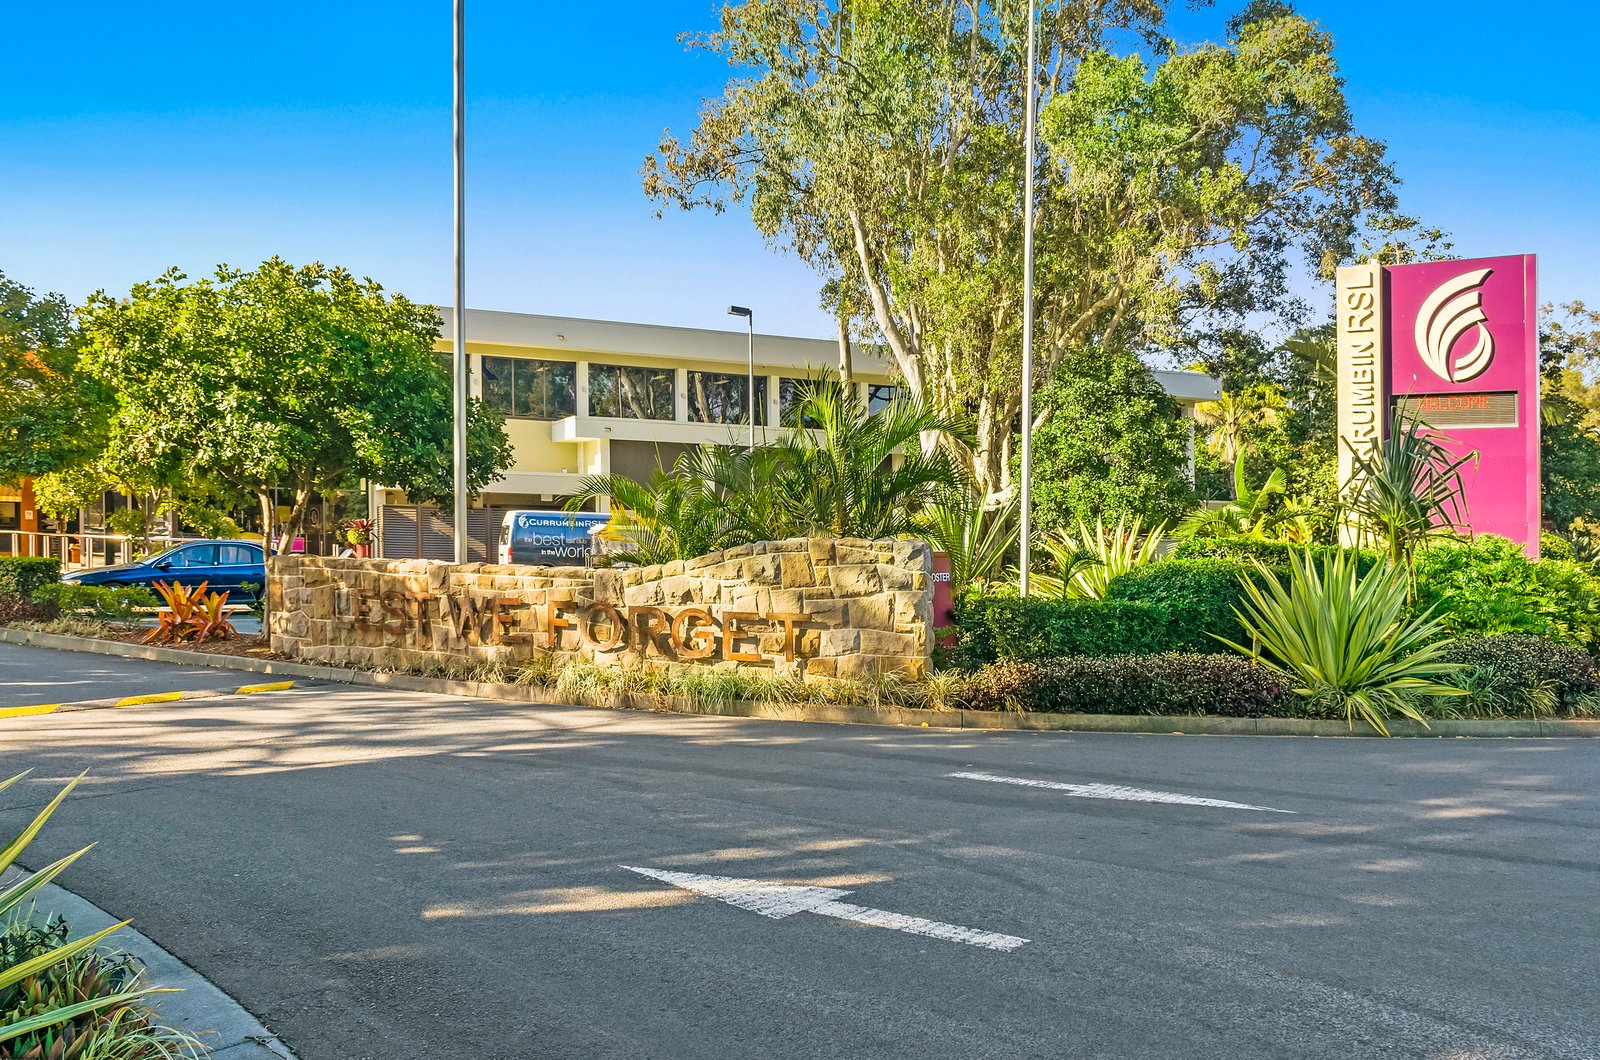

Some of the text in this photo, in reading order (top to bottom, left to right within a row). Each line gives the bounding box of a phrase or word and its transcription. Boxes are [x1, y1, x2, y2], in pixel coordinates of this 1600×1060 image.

[1346, 271, 1375, 497] RRUMBIN RSL
[1415, 395, 1490, 411] WELCOME
[533, 531, 565, 546] best
[331, 588, 812, 663] LEST WE FORGET
